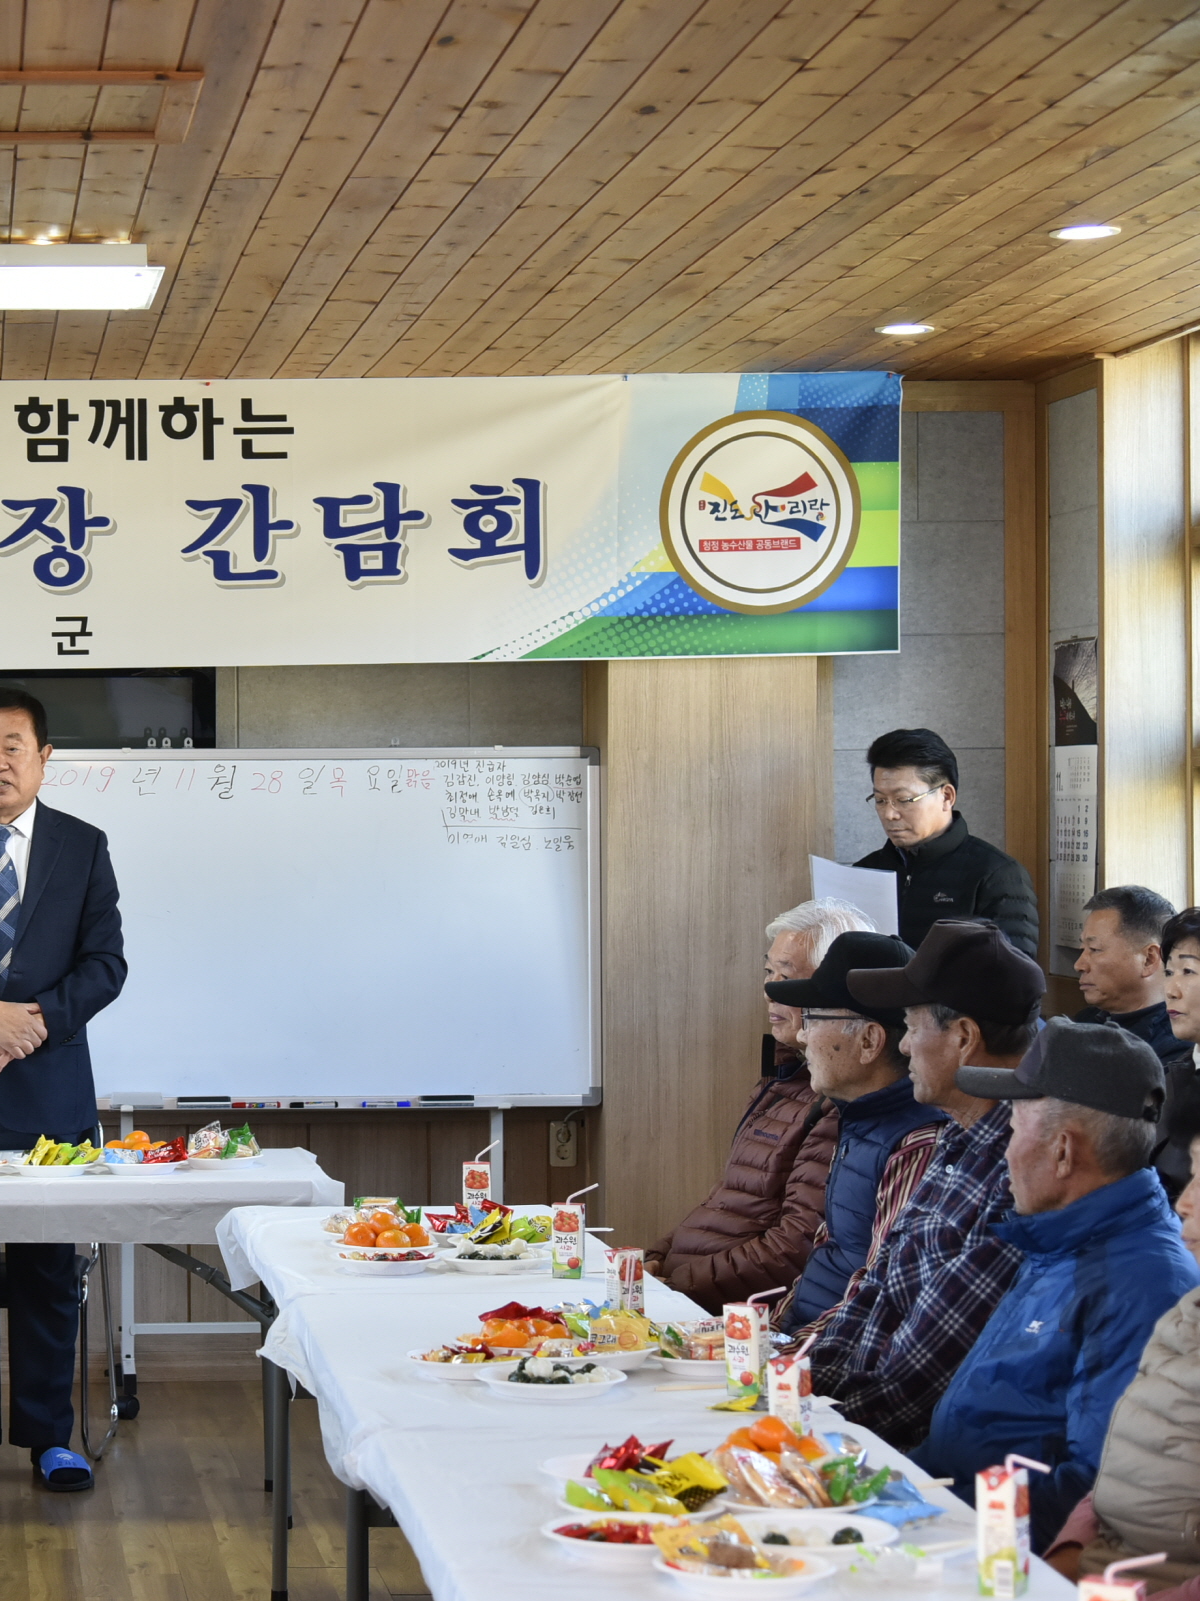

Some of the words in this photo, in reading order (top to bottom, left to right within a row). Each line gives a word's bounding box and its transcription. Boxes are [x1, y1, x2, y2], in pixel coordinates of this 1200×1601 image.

[14, 396, 294, 463] 함께하는
[180, 477, 543, 584] 간담회
[703, 540, 719, 551] 청정
[721, 540, 753, 550] 농수산물
[756, 539, 797, 550] 공동브랜드
[132, 766, 161, 796] 년
[175, 768, 195, 791] 11
[207, 764, 237, 799] 월
[250, 770, 283, 794] 28
[299, 765, 326, 795] 일
[330, 767, 347, 797] 목
[467, 1190, 487, 1200] 과수원
[555, 1234, 578, 1246] 과수원
[727, 1342, 749, 1356] 과수원
